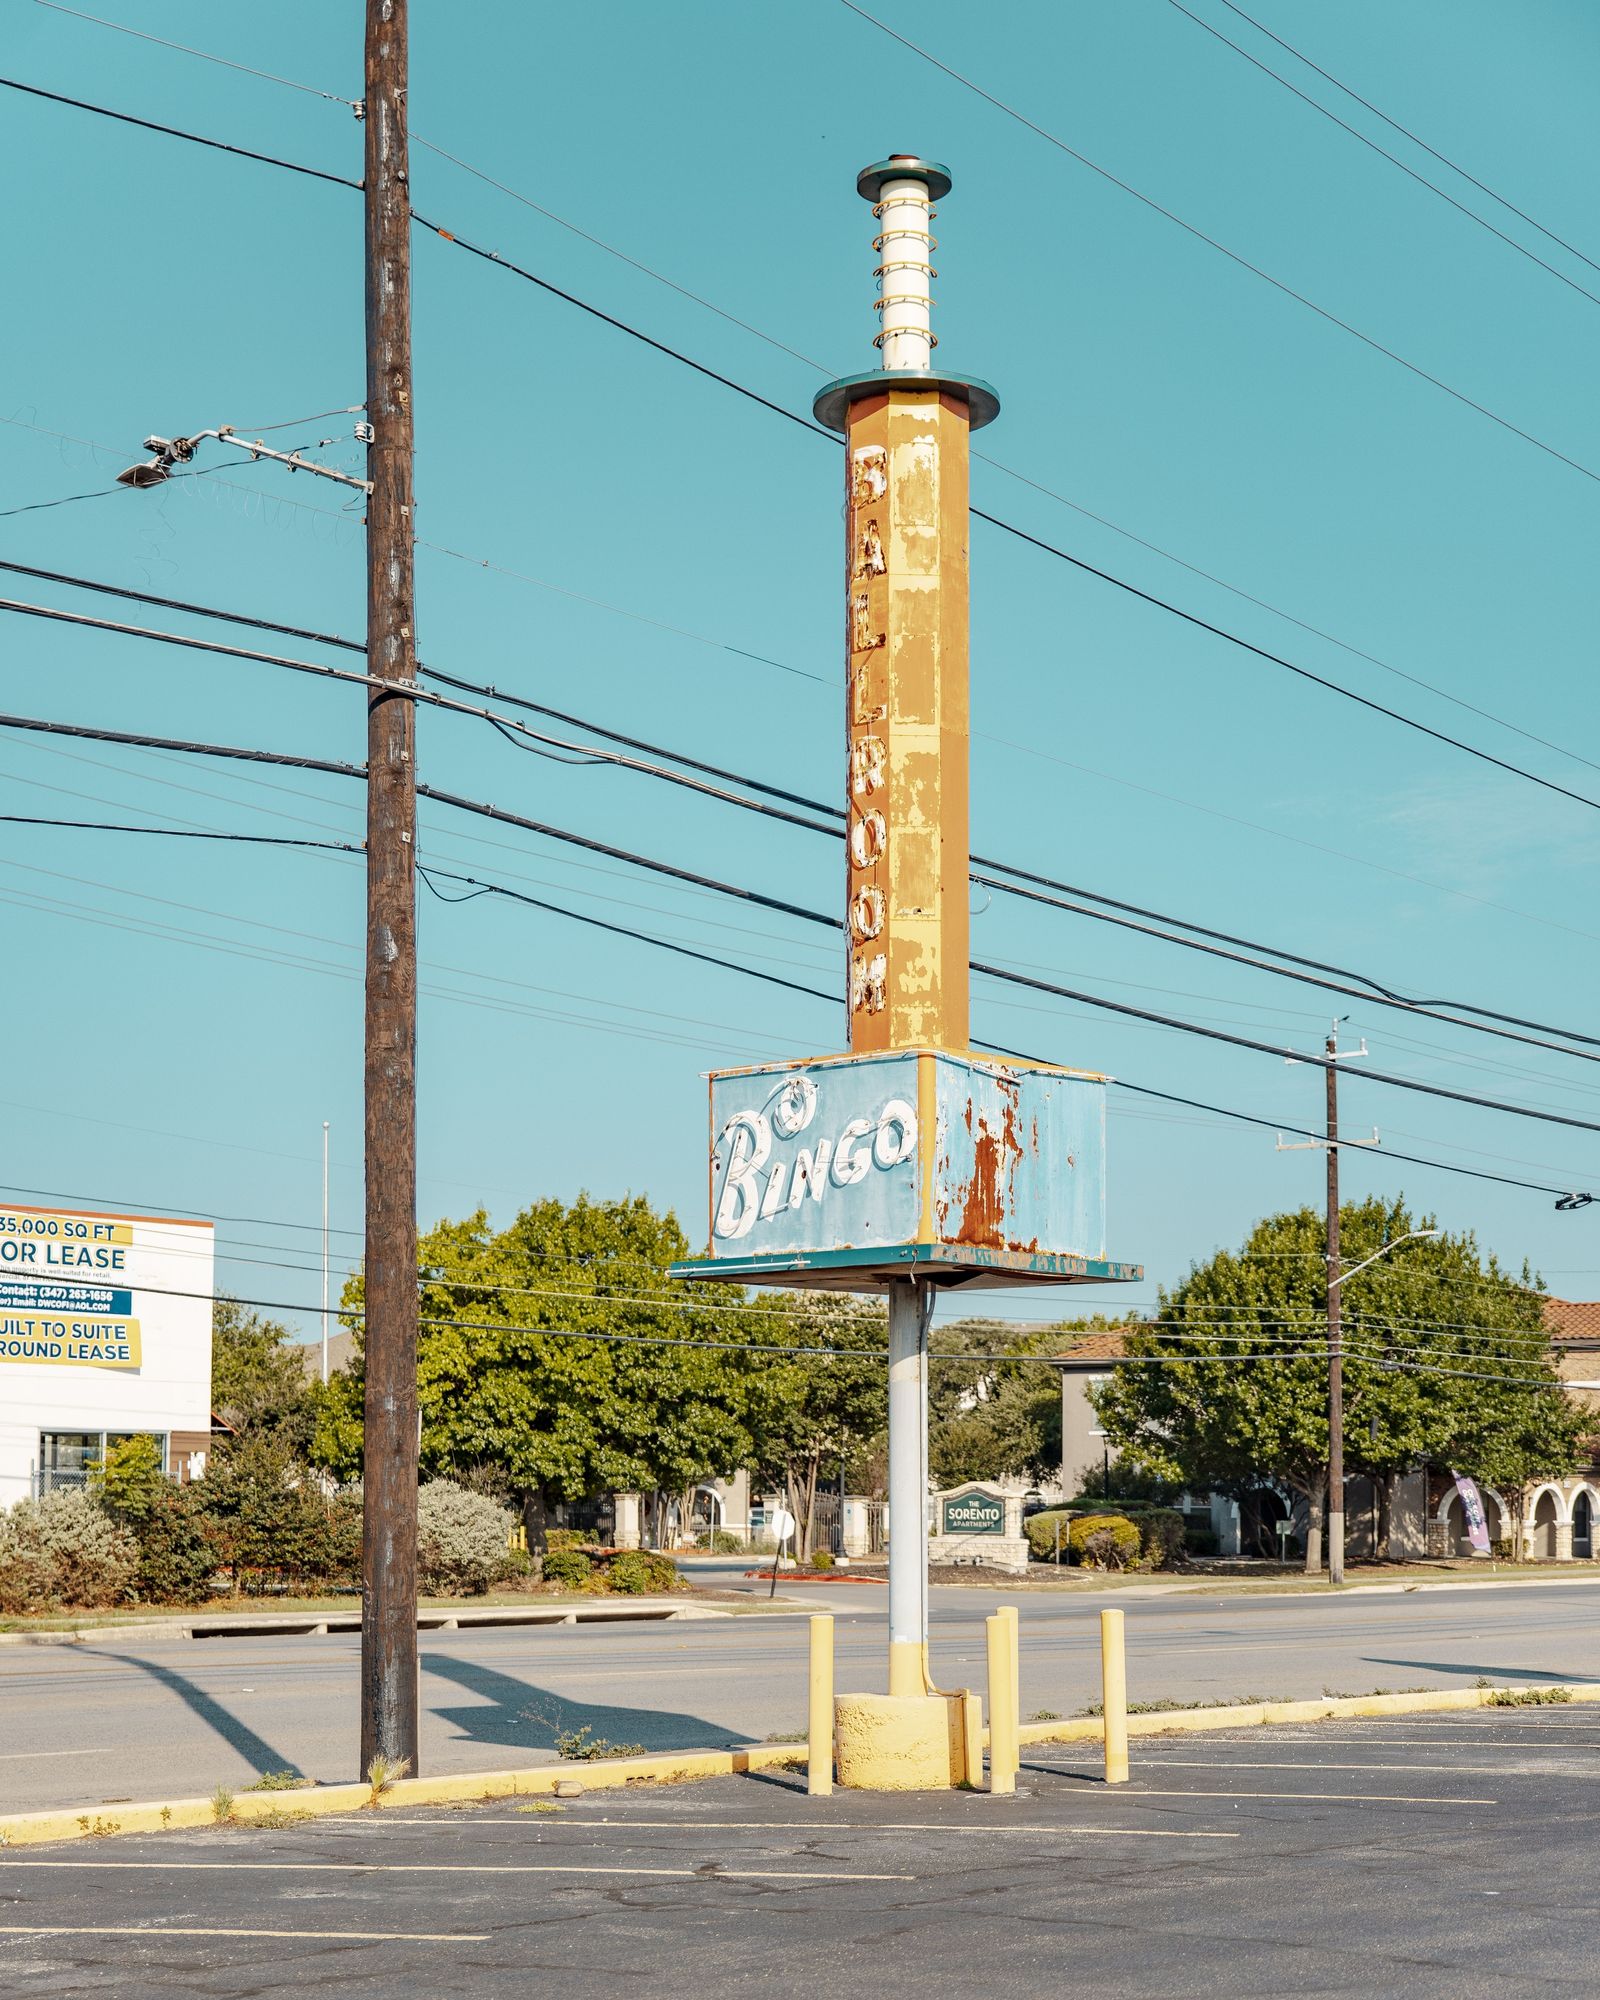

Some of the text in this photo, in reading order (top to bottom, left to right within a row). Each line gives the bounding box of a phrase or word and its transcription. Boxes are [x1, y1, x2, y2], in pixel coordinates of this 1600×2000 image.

[851, 445, 888, 1014] BALLROOM
[714, 1077, 918, 1239] BINGO
[64, 1222, 88, 1238] SQ
[94, 1225, 115, 1241] FT
[1, 1241, 125, 1270] OR LEASE
[13, 1297, 36, 1307] Email:
[40, 1286, 67, 1300] (347)
[69, 1288, 113, 1302] 263-1656
[41, 1321, 66, 1337] TO
[72, 1323, 126, 1339] SUITE
[68, 1344, 130, 1360] LEASE
[948, 1508, 999, 1520] SORENTO
